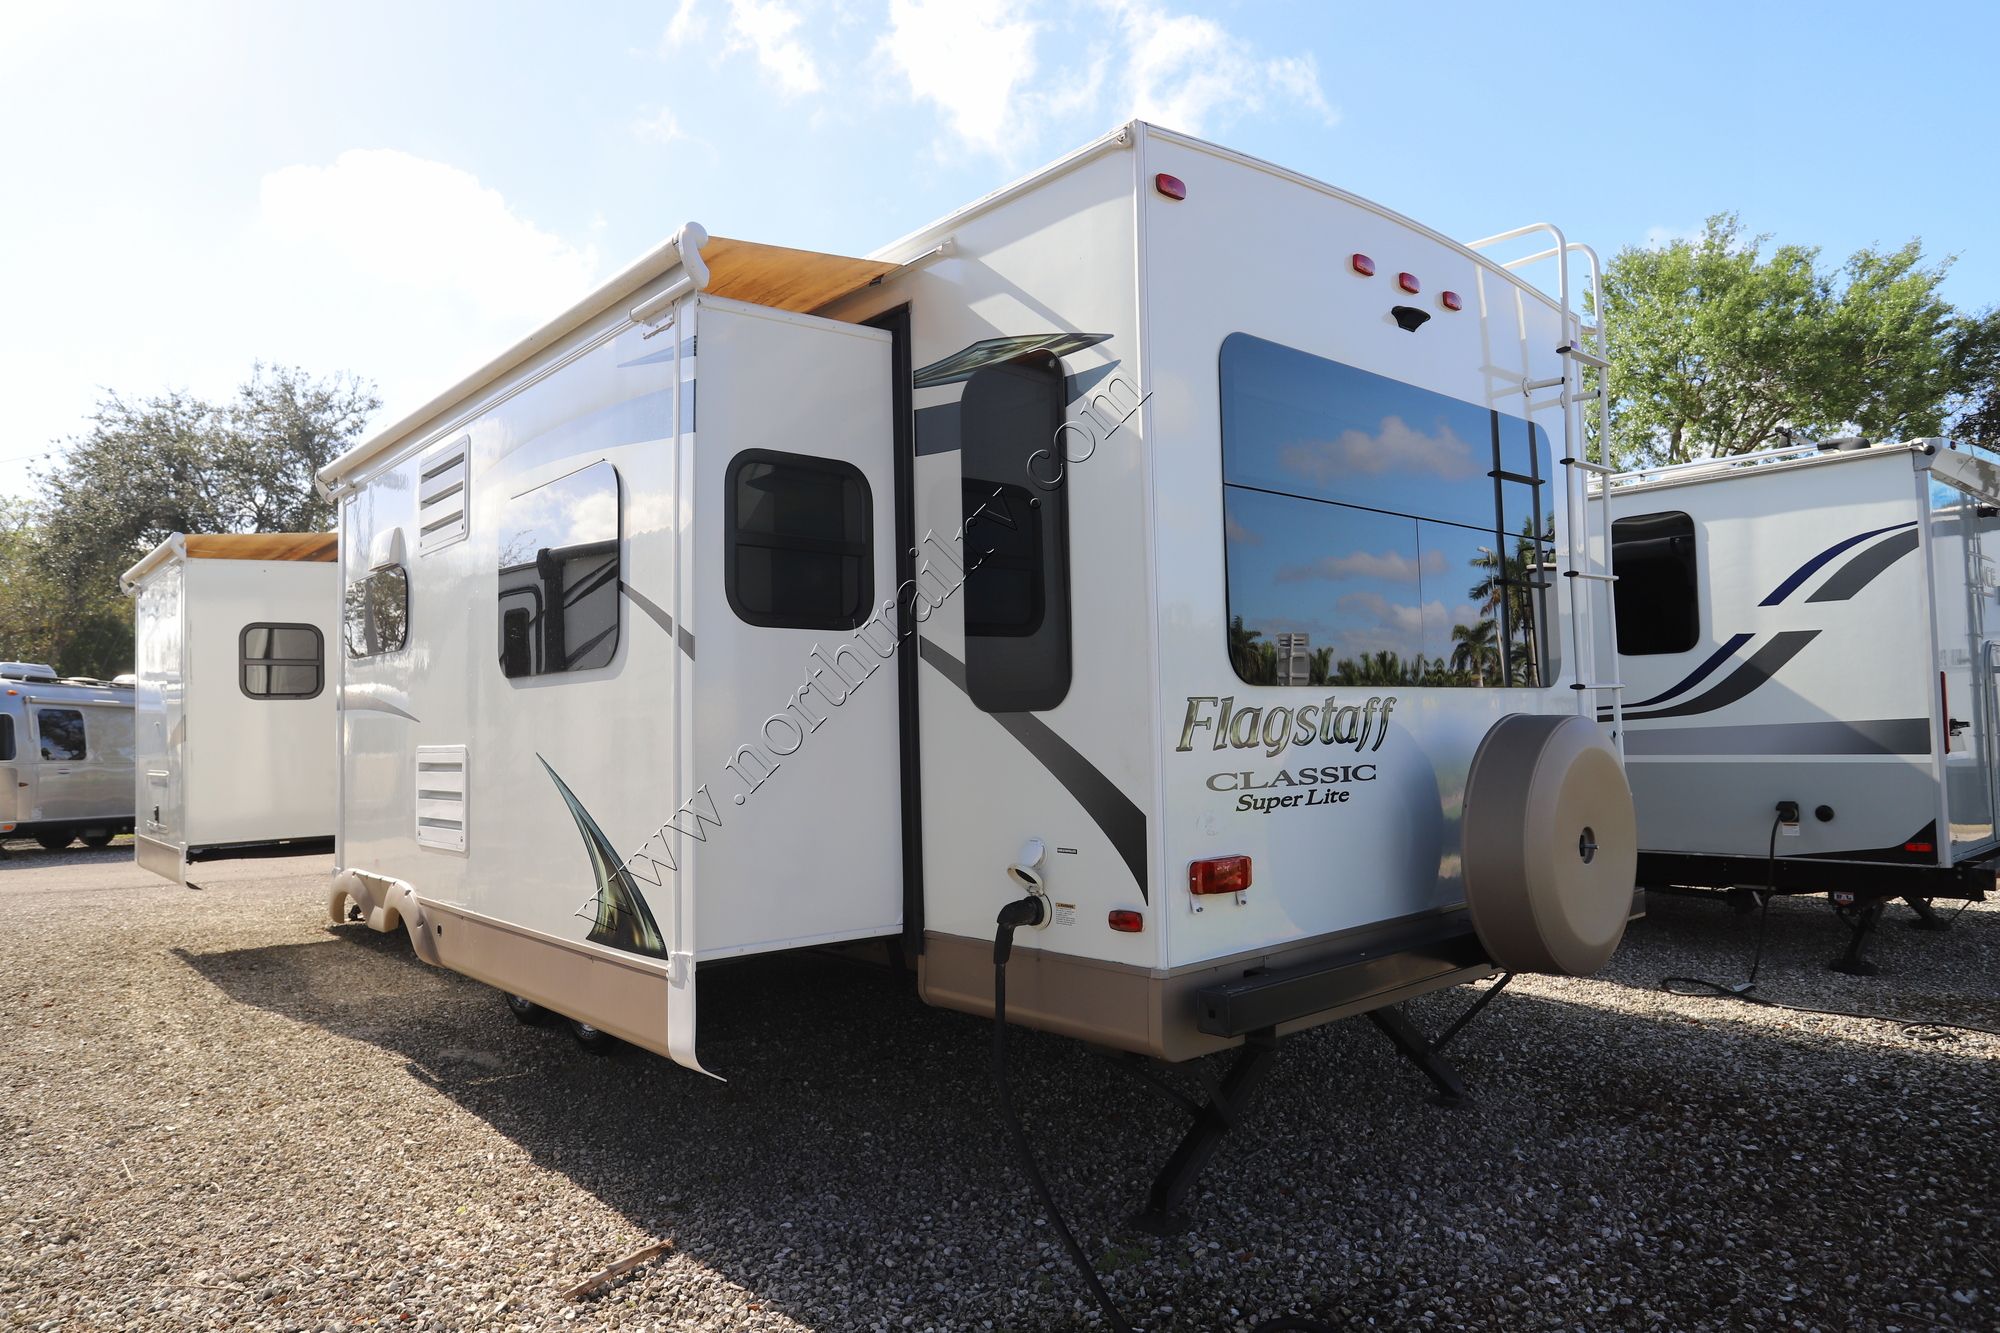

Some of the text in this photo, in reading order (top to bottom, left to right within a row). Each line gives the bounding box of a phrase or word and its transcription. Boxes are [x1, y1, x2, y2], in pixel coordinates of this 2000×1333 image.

[1176, 696, 1397, 757] Flagstaff
[1206, 764, 1377, 791] CLASSIC
[1236, 788, 1350, 814] Super Lite
